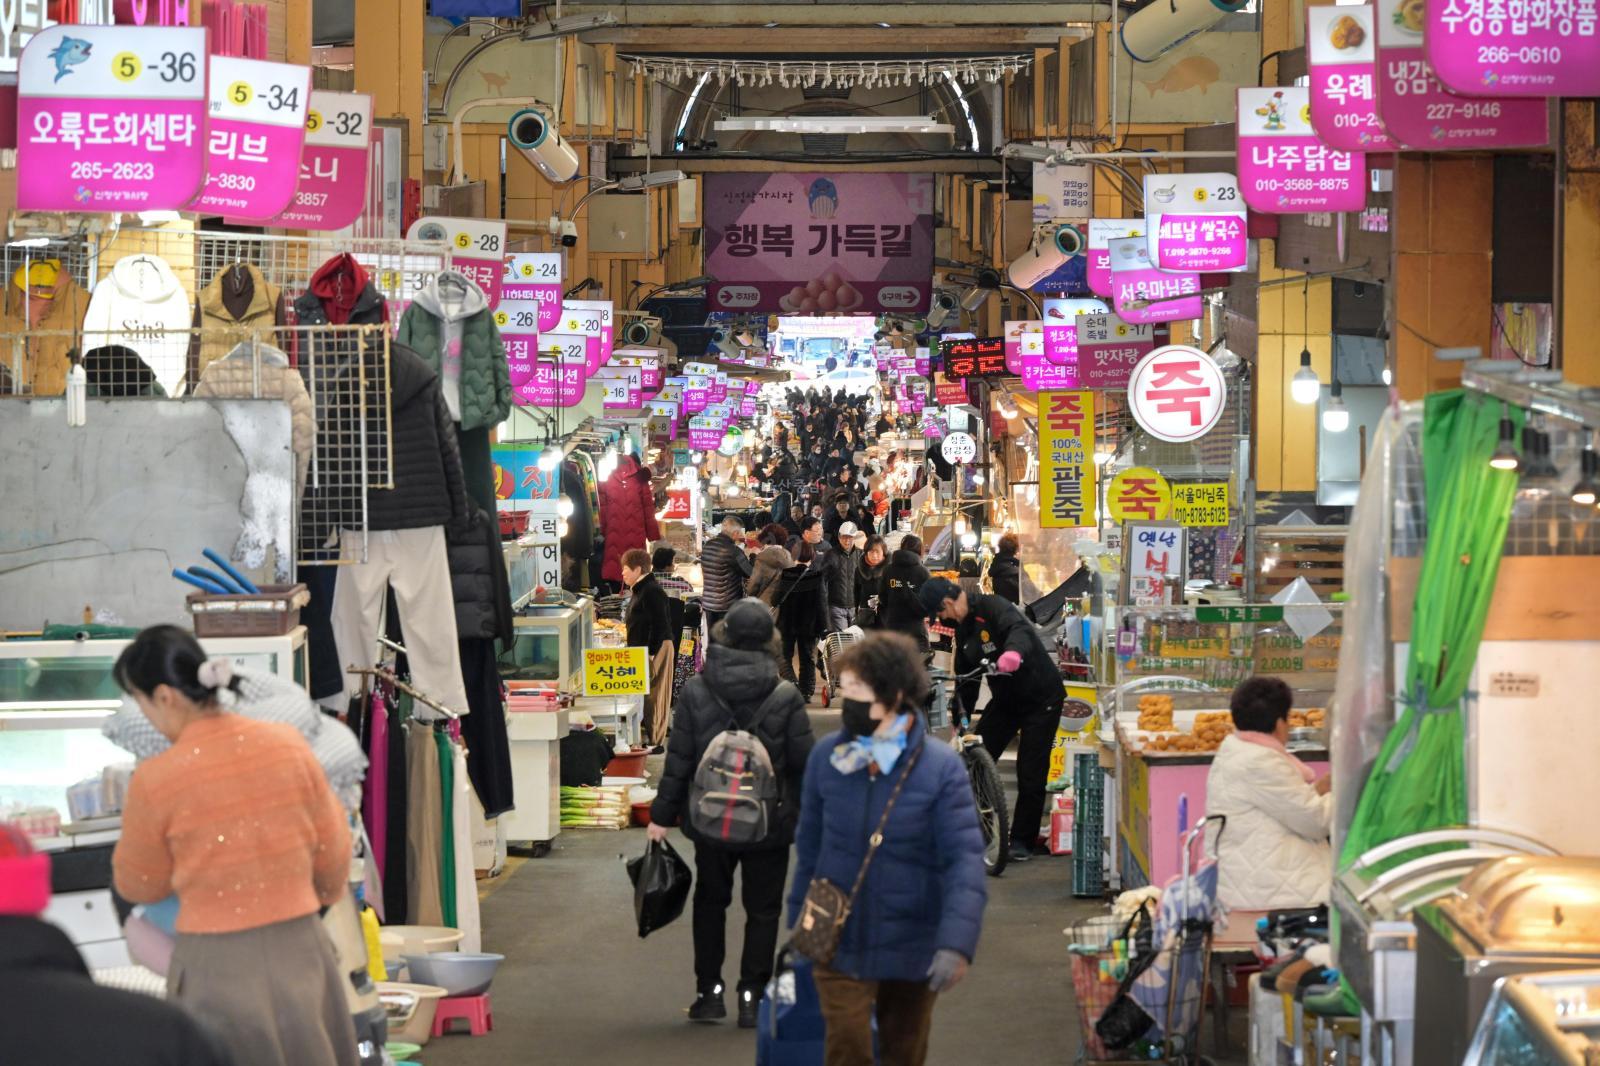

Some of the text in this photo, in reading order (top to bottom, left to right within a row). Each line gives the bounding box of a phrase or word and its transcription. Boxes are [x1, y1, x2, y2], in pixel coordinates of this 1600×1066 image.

[1478, 47, 1561, 63] 266-0610
[1323, 74, 1376, 105] 옥례
[1426, 103, 1500, 120] 227-9146
[29, 111, 197, 151] 오륙도회센타
[71, 161, 154, 180] 265-2623
[1255, 178, 1350, 191] 010-3568-8875
[1201, 220, 1241, 241] 쌀국수
[723, 223, 912, 258] 행복 가득길
[1120, 277, 1197, 300] 서울마님죽
[121, 319, 166, 340] Sina
[1094, 347, 1139, 366] 맛자랑
[1145, 360, 1211, 426] 죽
[1046, 395, 1085, 437] 죽
[1051, 439, 1082, 449] 100%
[1051, 452, 1084, 464] 국내산
[1051, 466, 1085, 526] 팥죽
[1117, 478, 1162, 521] 죽
[1175, 487, 1227, 504] 서울마님죽
[586, 650, 631, 665] 엄마가 만든
[596, 665, 637, 680] 식혜
[590, 679, 643, 692] 6,000원
